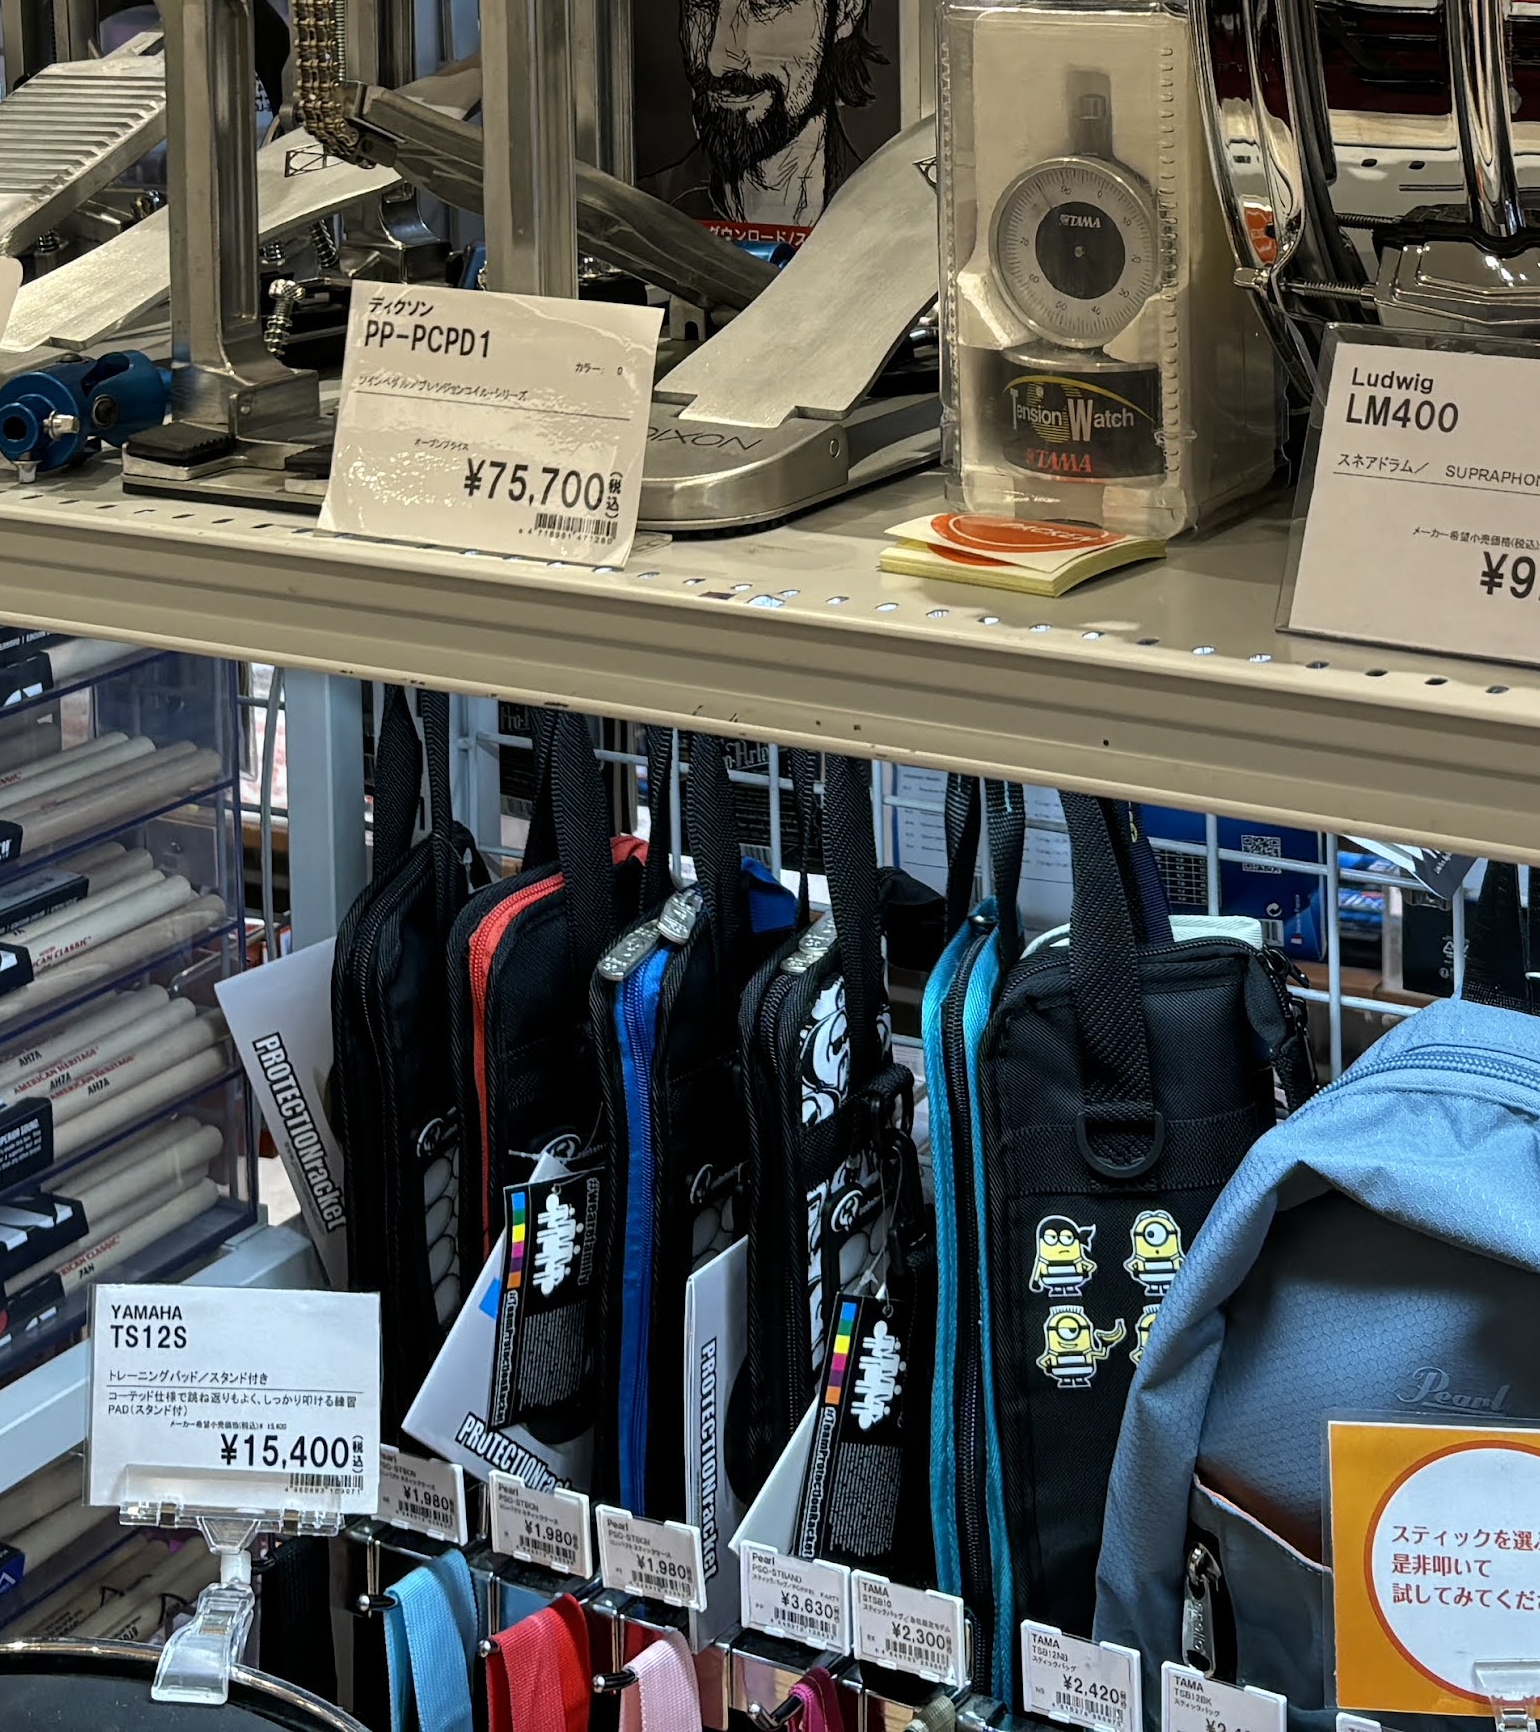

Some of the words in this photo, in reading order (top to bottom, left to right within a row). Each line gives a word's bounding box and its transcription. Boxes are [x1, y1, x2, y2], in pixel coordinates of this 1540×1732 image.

[368, 296, 434, 318] ディクソン
[363, 319, 492, 358] PP-PCPD1
[1351, 367, 1435, 395] Ludwig
[1010, 388, 1064, 430] Tension
[1068, 397, 1135, 443] Watch
[1345, 393, 1459, 434] LM400
[463, 457, 605, 511] ¥75,700
[606, 471, 624, 519] (税込)
[253, 1031, 349, 1234] PROTECTIONracket
[111, 1305, 183, 1321] YAMAHA
[110, 1326, 188, 1350] TS12S
[109, 1369, 268, 1386] トレーニングパッド/スタンド付き
[1394, 1364, 1510, 1418] Pearl
[108, 1403, 189, 1418] PAD(スタンド付)
[220, 1434, 349, 1469] ¥15,400
[351, 1434, 365, 1474] (税込)
[696, 1334, 720, 1580] PROTECTIONracket
[751, 1552, 776, 1566] Pearl
[1391, 1553, 1493, 1578] 是非叩いて
[862, 1581, 890, 1598] TAMA
[781, 1589, 834, 1620] ¥3,630
[892, 1621, 946, 1651] ¥2,300
[1031, 1632, 1061, 1650] TAMA
[1063, 1675, 1120, 1704] ¥2,420
[1174, 1676, 1204, 1693] TAMA
